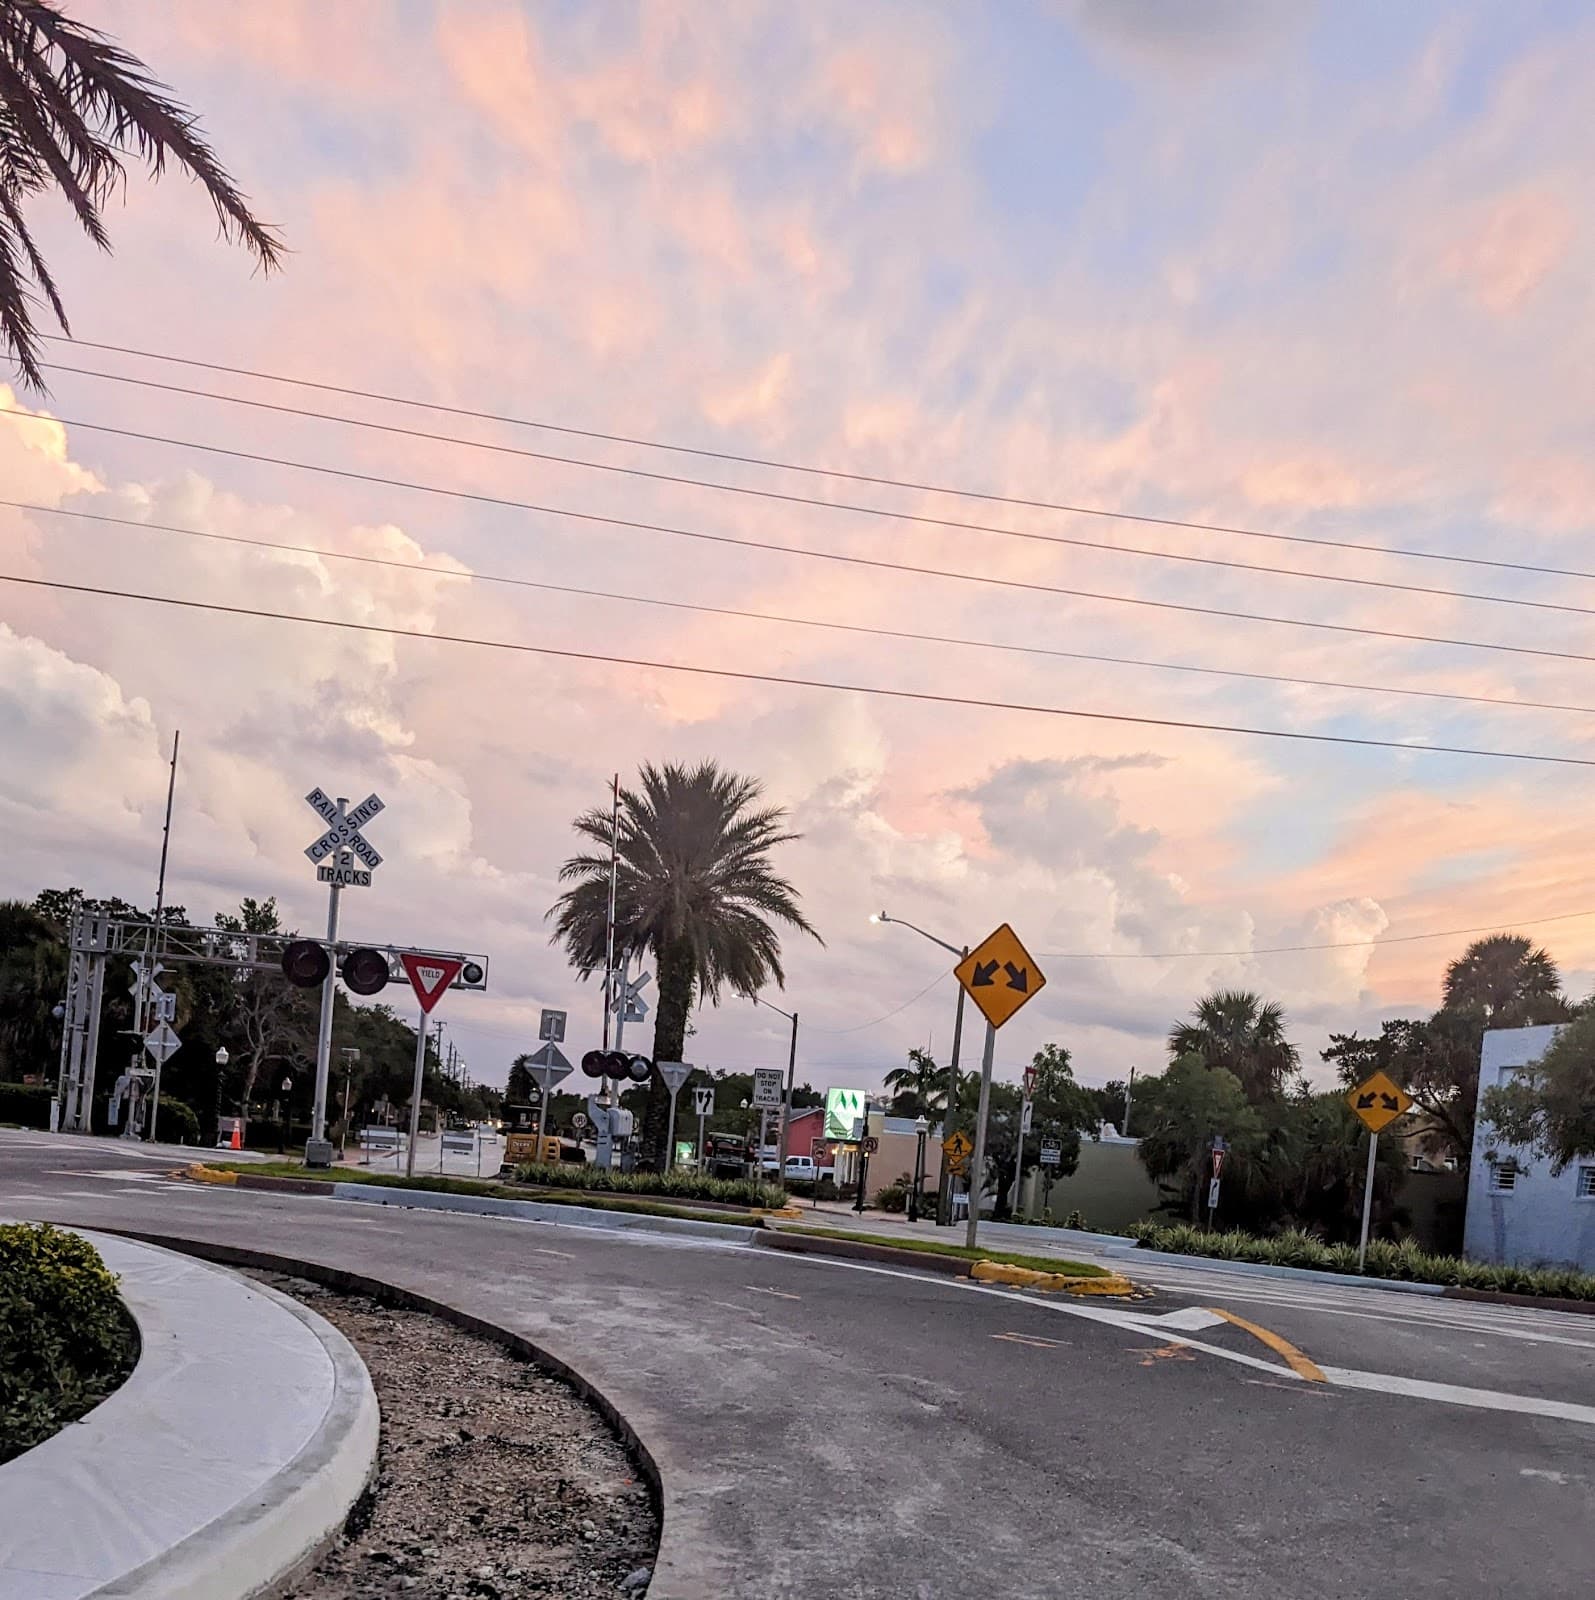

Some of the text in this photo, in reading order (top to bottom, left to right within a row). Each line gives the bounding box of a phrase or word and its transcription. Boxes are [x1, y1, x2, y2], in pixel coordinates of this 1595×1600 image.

[310, 791, 379, 867] RAIL ROAD
[312, 800, 379, 858] CROSSING
[340, 852, 350, 865] 2
[319, 866, 370, 885] TRACKS
[421, 969, 440, 979] YIELD
[756, 1071, 781, 1080] DO NOT
[755, 1095, 779, 1103] TRACKS
